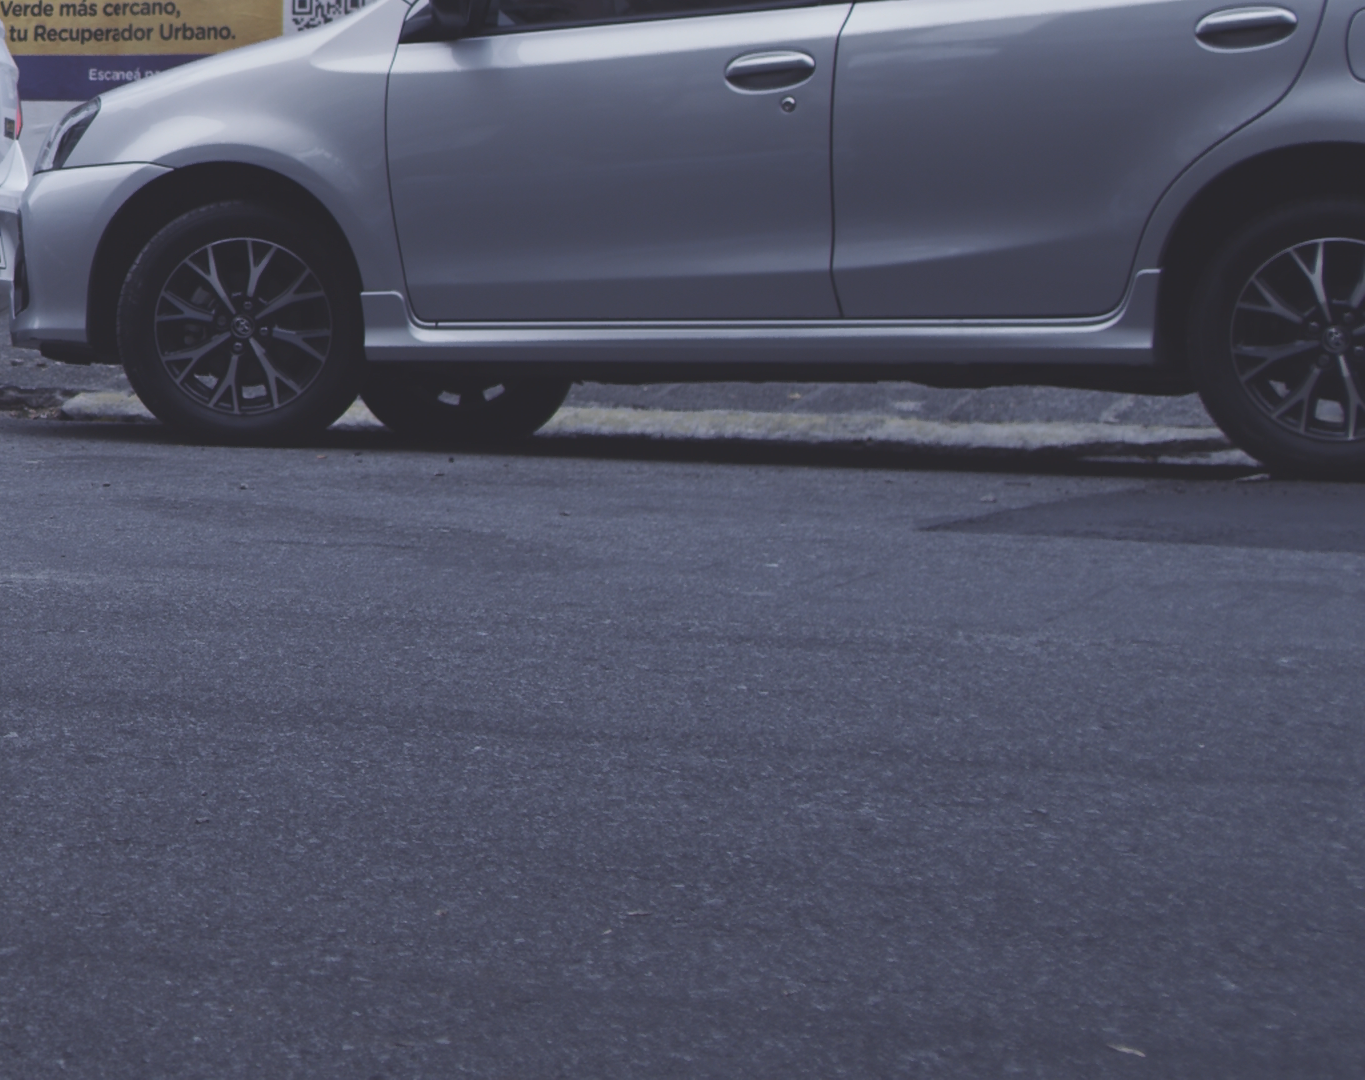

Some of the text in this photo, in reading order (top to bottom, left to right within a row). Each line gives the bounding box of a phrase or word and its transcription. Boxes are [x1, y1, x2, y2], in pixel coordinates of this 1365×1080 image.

[0, 0, 56, 17] Verde
[103, 1, 181, 19] cercano,
[9, 23, 236, 45] tu Recuperador Urbano.
[88, 66, 141, 81] Escaneá
